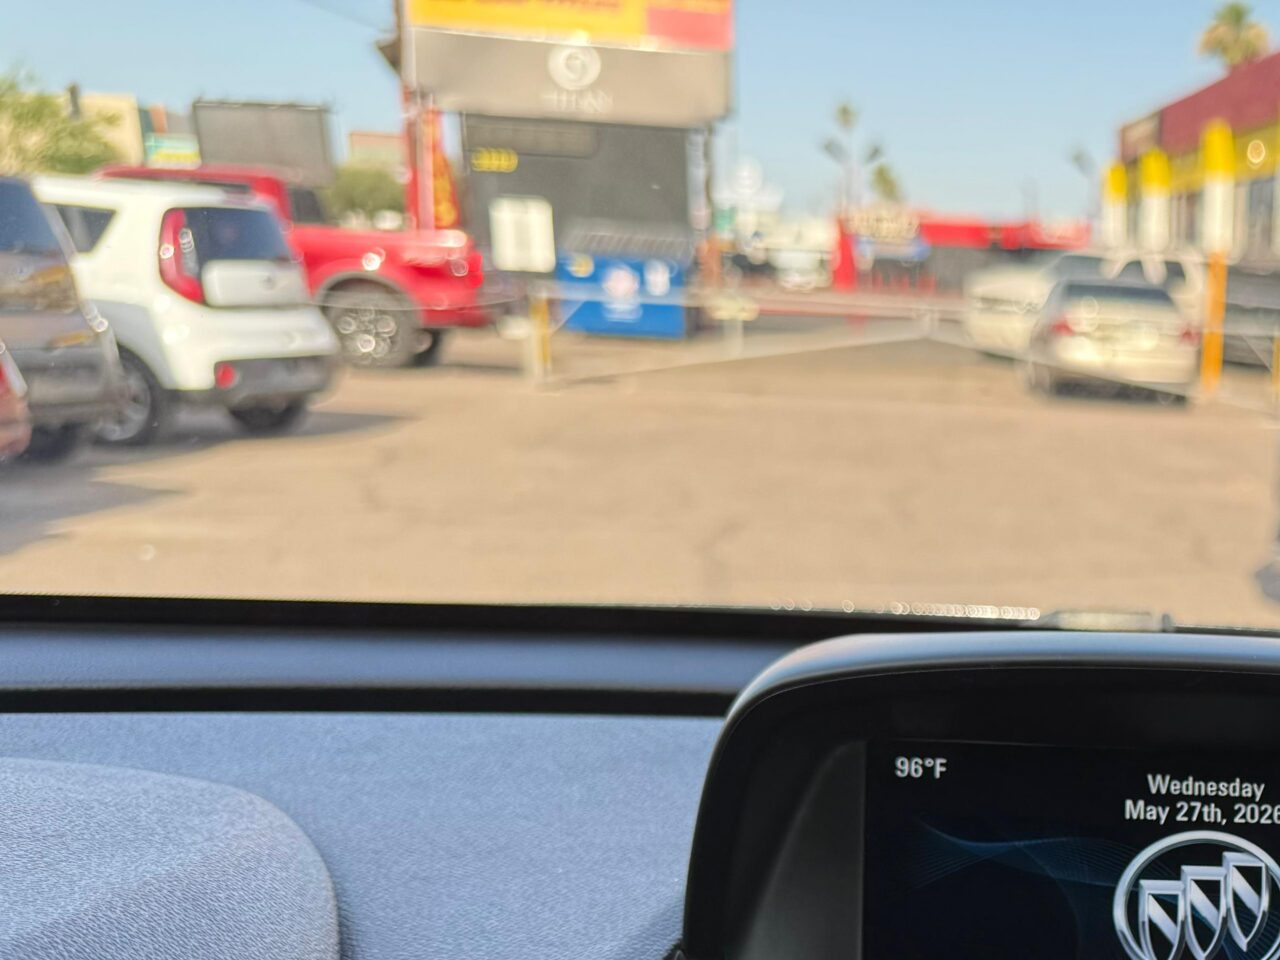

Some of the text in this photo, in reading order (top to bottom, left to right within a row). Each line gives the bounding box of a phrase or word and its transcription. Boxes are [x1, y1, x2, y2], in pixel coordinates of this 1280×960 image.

[895, 756, 946, 778] 96°F
[1147, 773, 1264, 802] Wednesday
[1125, 799, 1168, 825] May
[1175, 801, 1227, 826] 27th,
